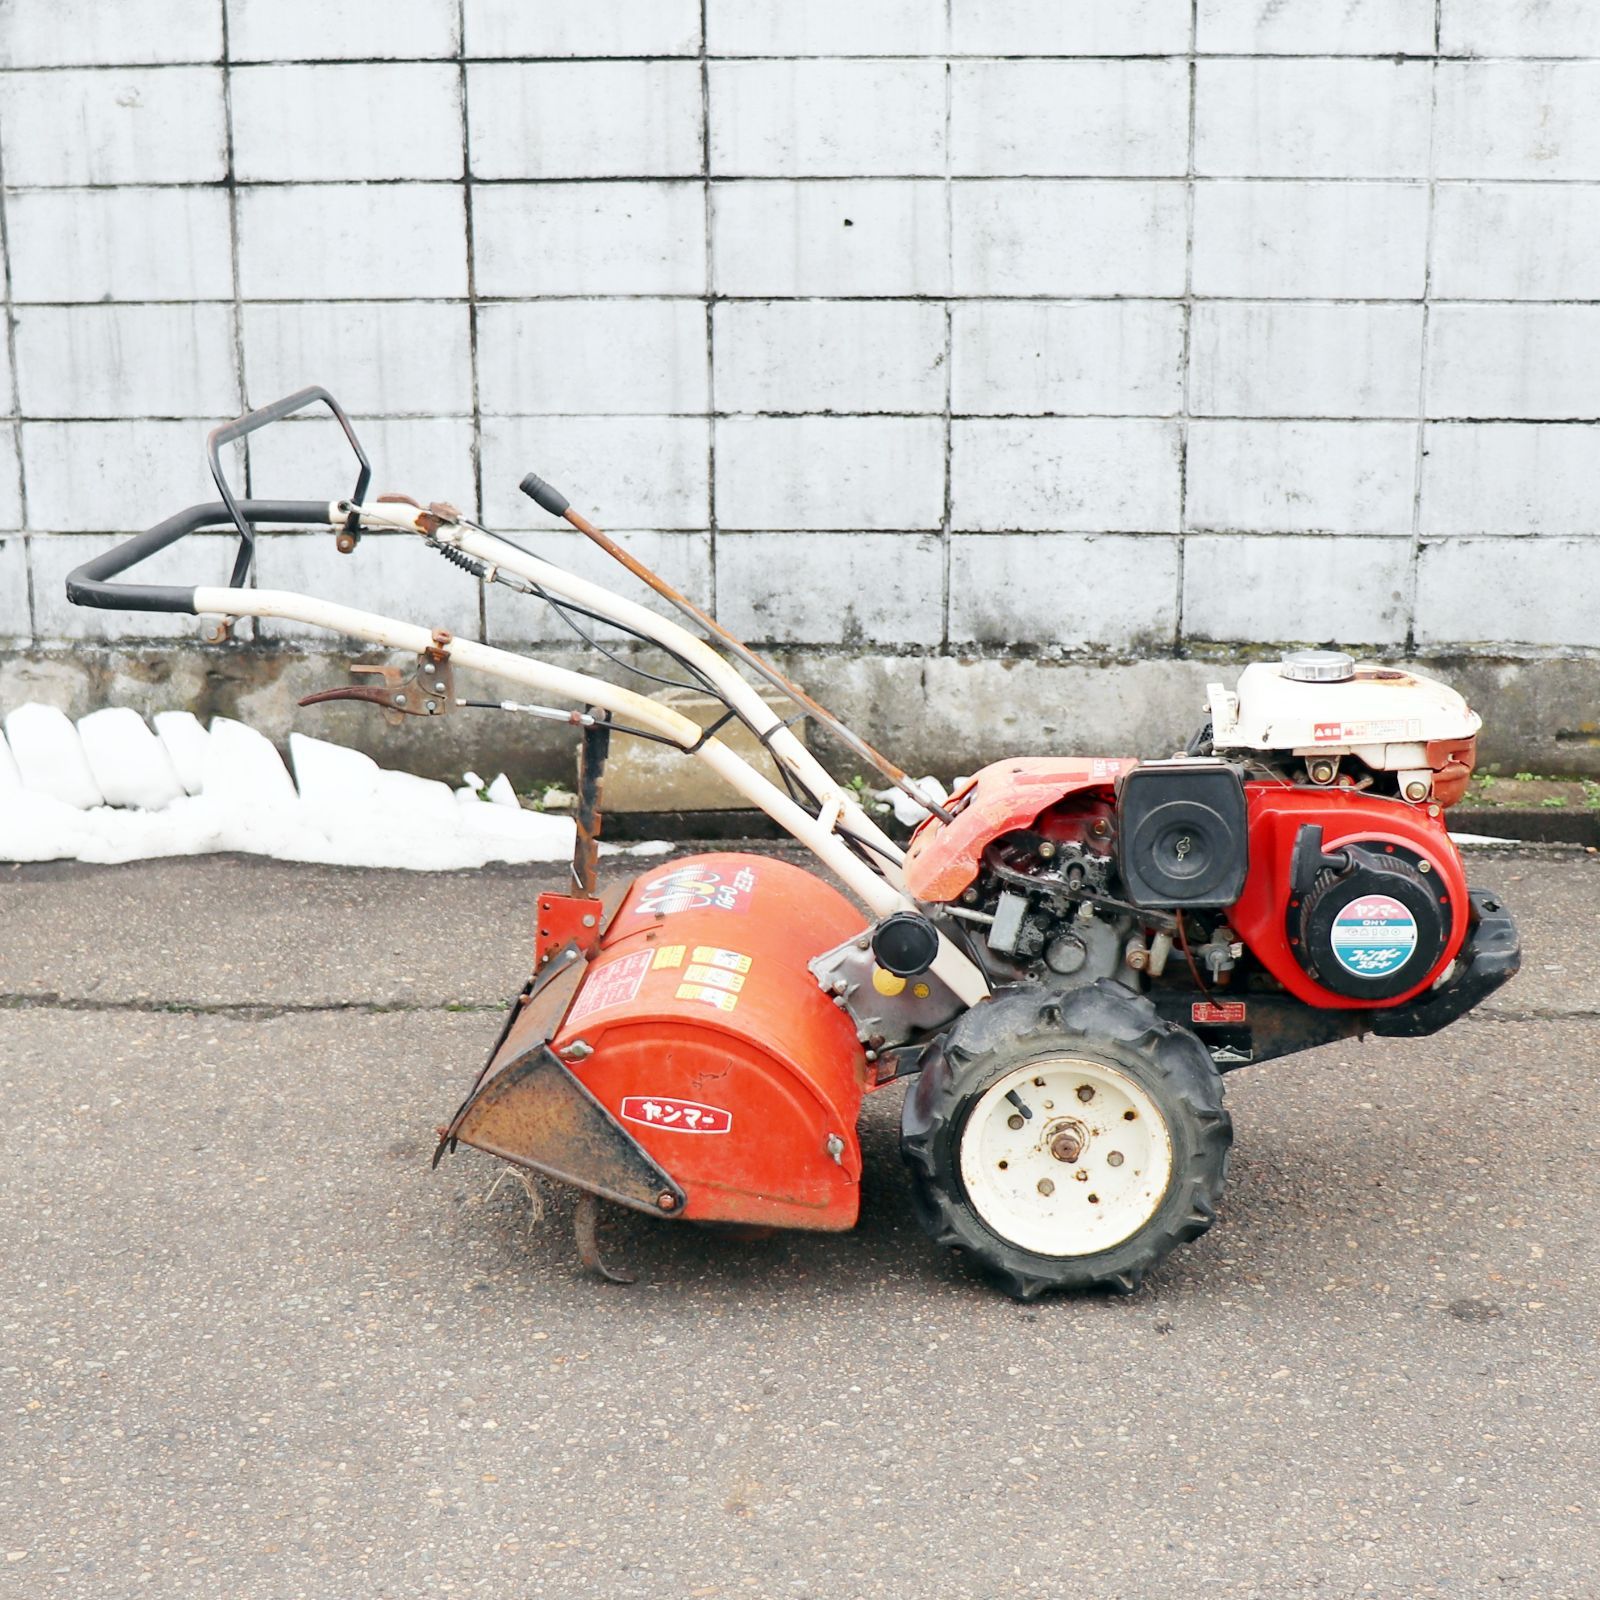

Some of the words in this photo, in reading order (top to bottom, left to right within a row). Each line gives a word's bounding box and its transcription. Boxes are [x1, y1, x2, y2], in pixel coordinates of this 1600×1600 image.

[1354, 904, 1399, 917] ヤンマー
[1348, 948, 1402, 962] フィンガー
[642, 1101, 715, 1129] ヤンマー
